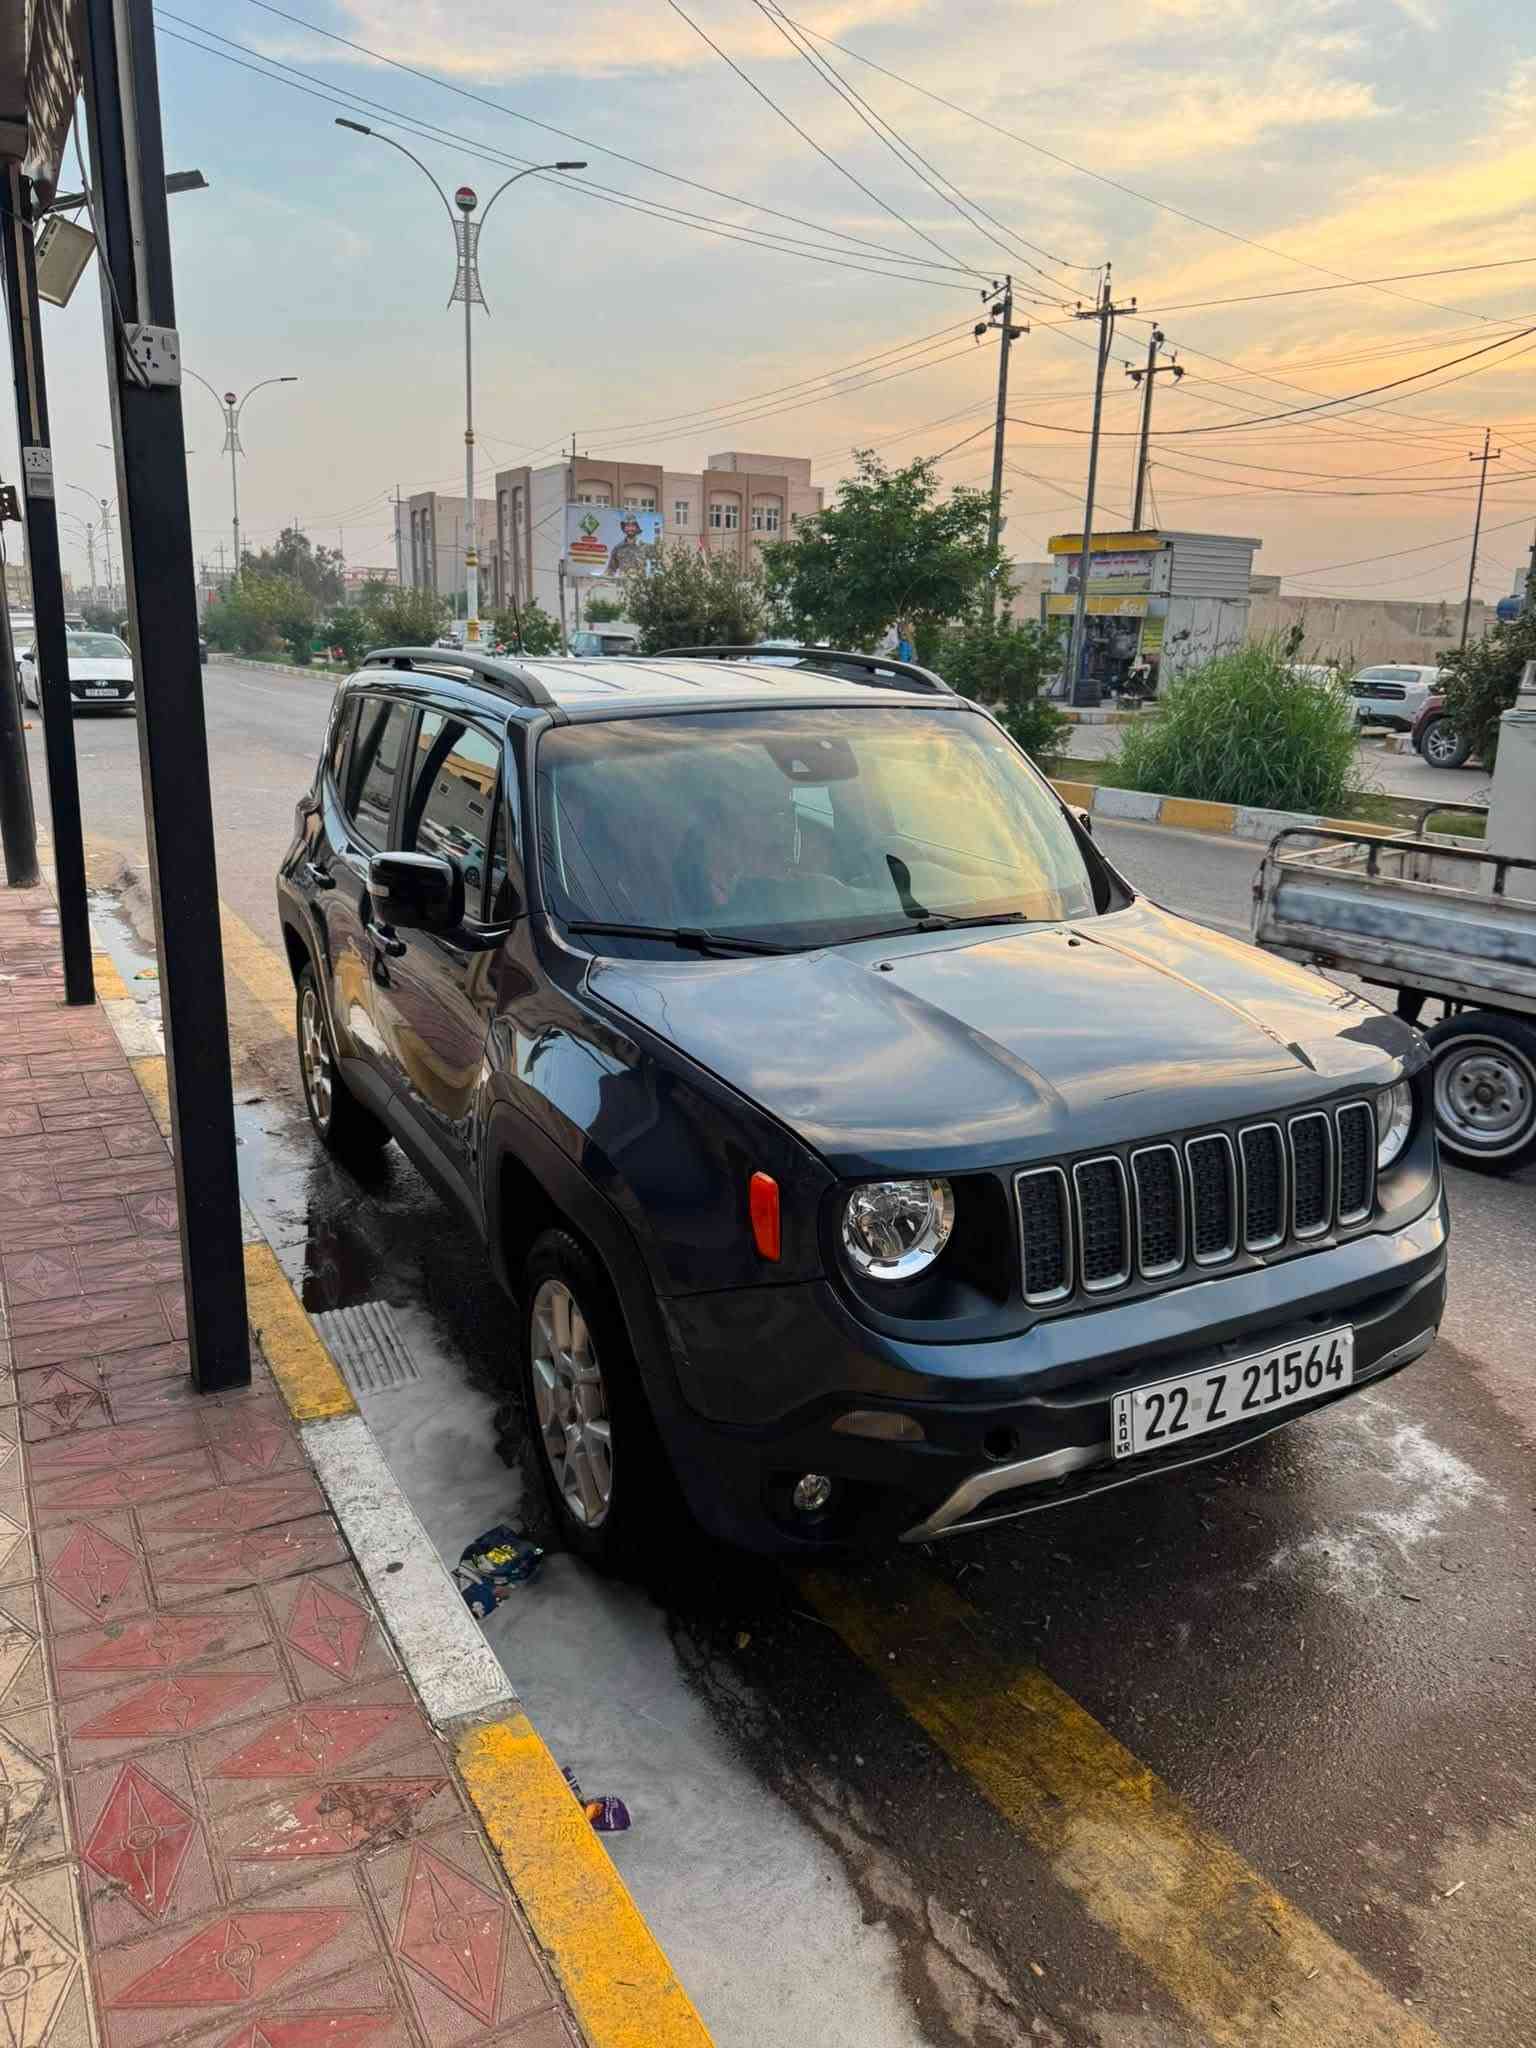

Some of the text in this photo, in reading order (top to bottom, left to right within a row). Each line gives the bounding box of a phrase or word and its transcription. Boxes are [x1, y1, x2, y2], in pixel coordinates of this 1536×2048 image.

[1145, 1339, 1343, 1441] 22 Z 21564
